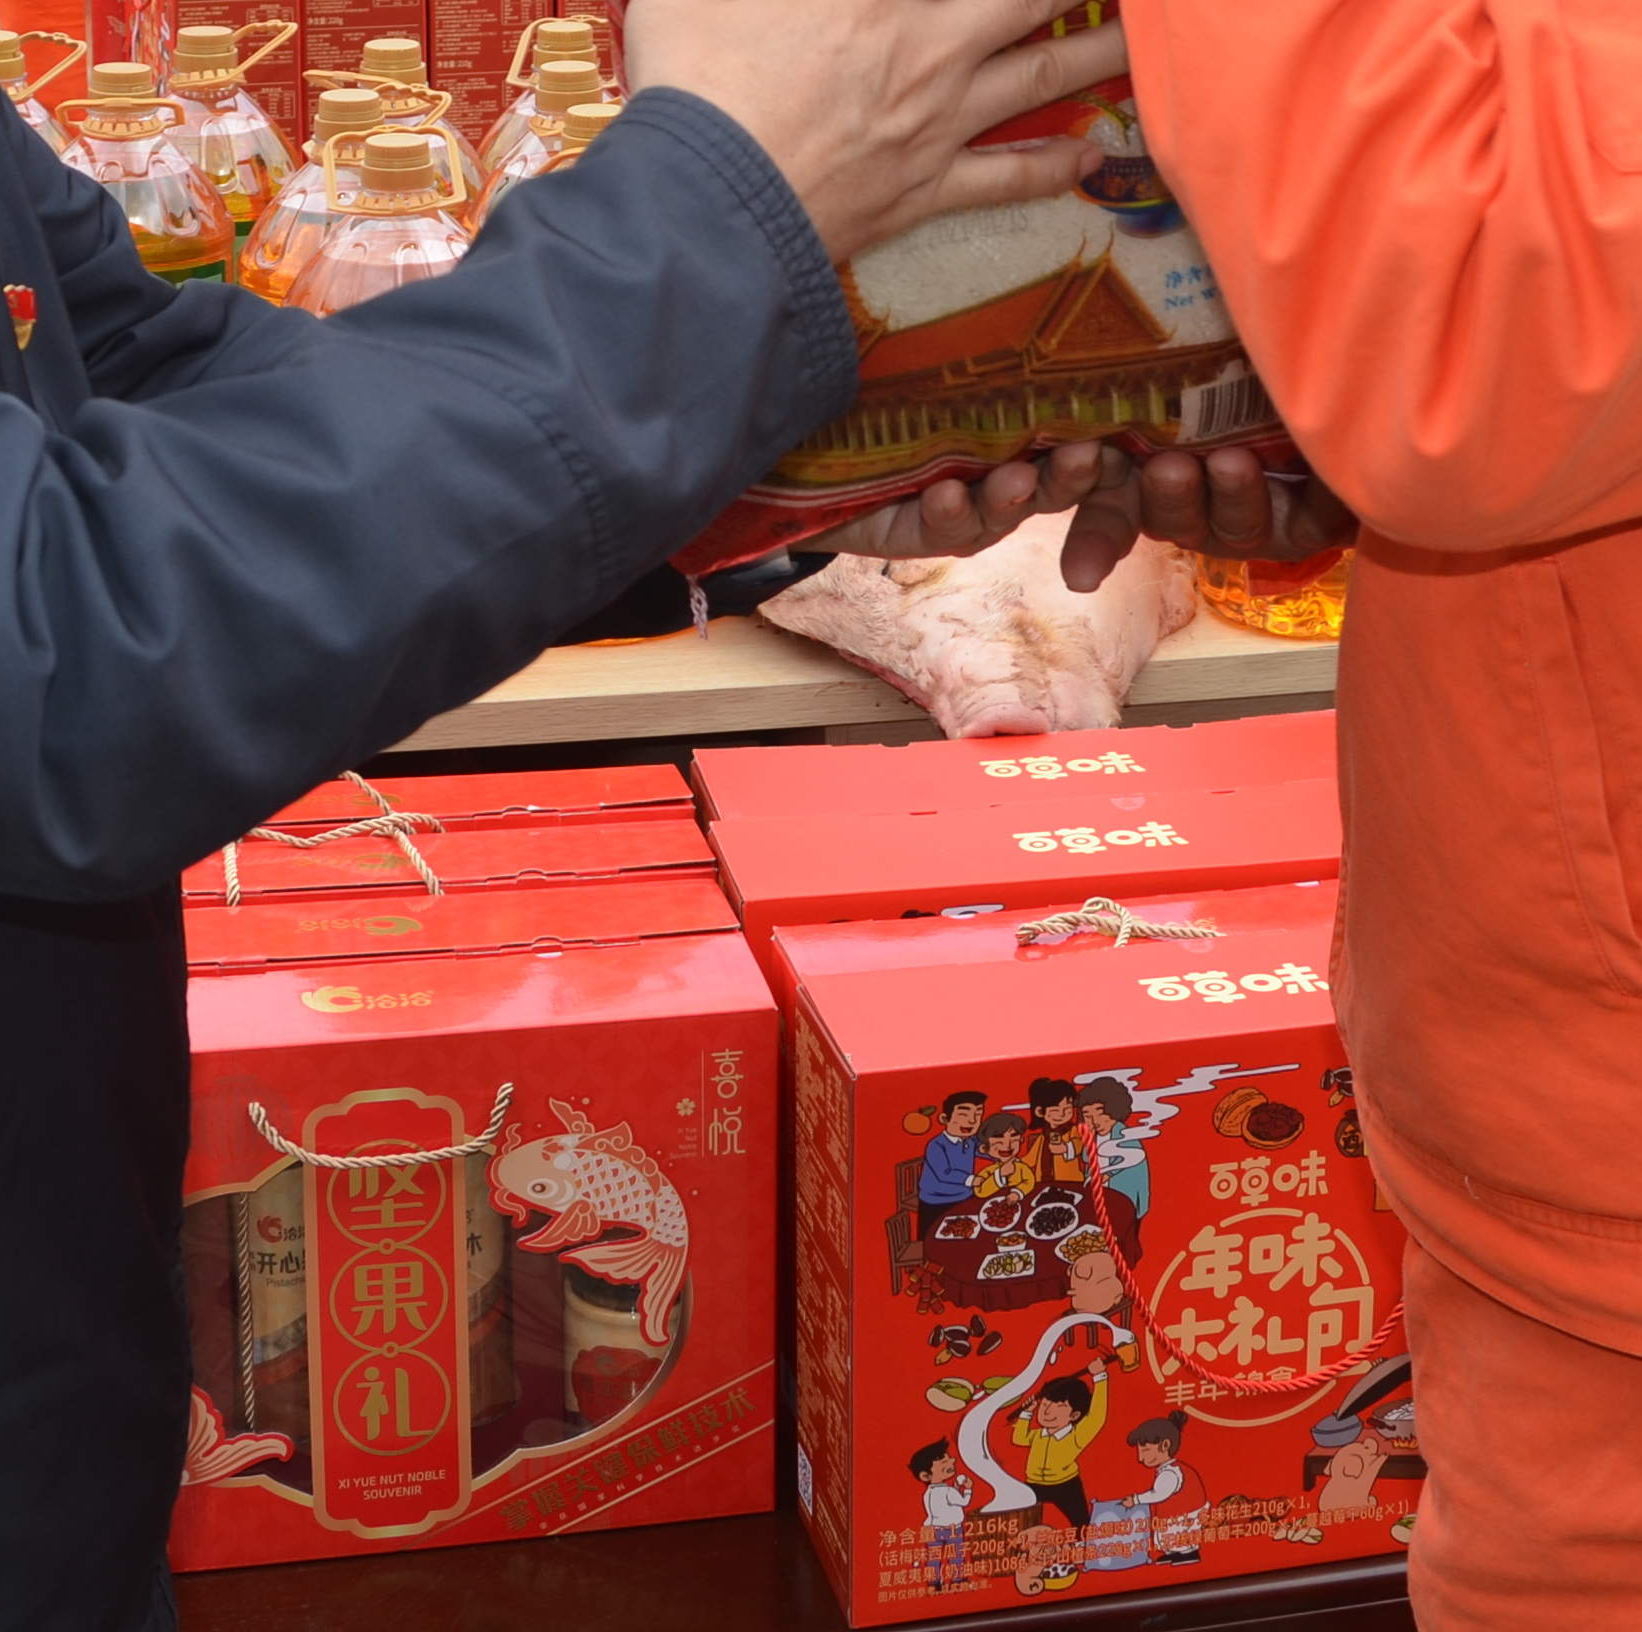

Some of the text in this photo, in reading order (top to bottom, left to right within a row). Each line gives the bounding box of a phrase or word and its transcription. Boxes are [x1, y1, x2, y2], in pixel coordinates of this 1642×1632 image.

[979, 750, 1147, 781] 百草味
[1012, 820, 1190, 855] 百草味
[1137, 961, 1331, 1005] 百草味
[1208, 1149, 1329, 1207] 百草味
[1178, 1211, 1344, 1299] 年味
[347, 1161, 435, 1442] 坚果礼
[363, 1485, 422, 1501] SOUVENIR
[379, 1473, 404, 1485] NUT
[407, 1469, 446, 1482] NOBLE
